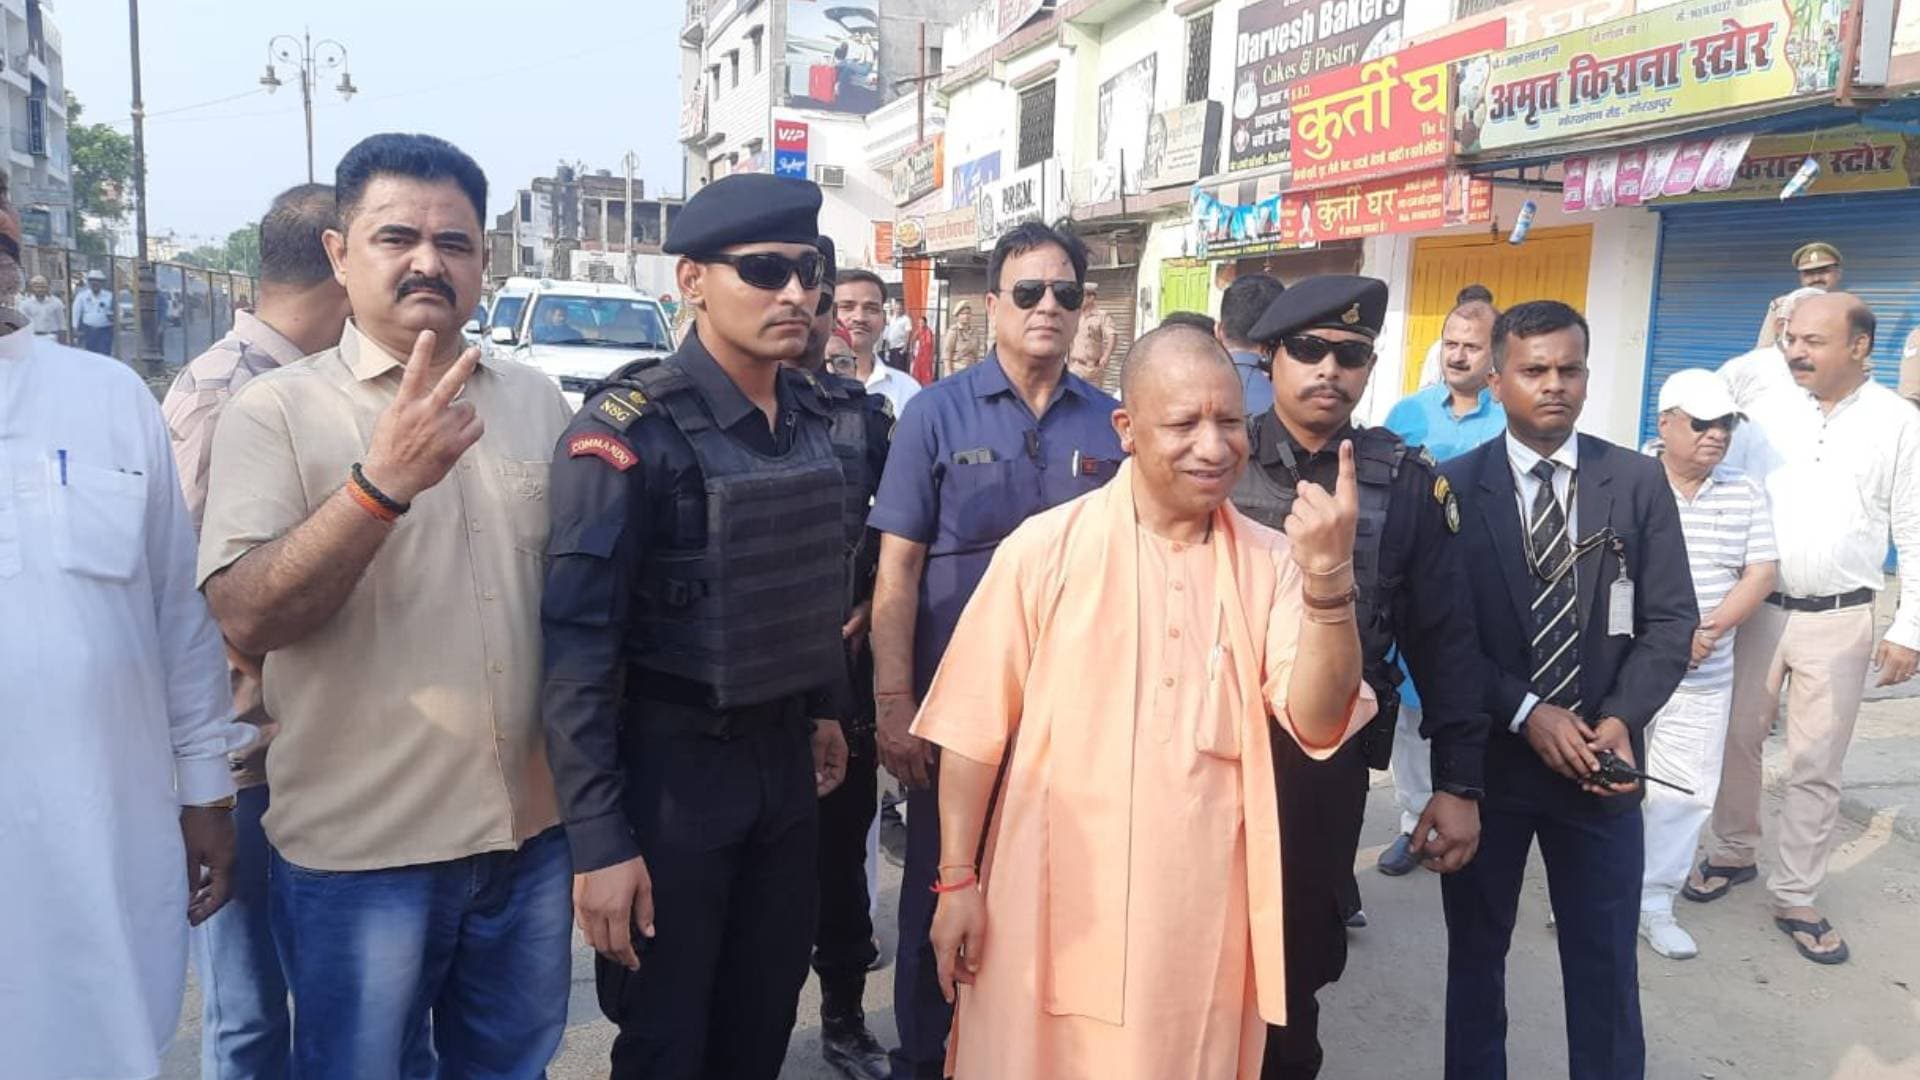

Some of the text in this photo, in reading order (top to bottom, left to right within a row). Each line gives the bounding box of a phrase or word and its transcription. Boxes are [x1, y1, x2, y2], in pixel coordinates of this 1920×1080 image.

[1237, 0, 1400, 67] Darvesh Bakers
[1263, 62, 1297, 86] Cakes
[1315, 42, 1359, 71] Pastry
[1489, 18, 1775, 128] अमृत किराना स्टोर
[1293, 56, 1399, 160] कुर्ती
[1402, 63, 1448, 115] घ
[778, 127, 806, 142] VIP
[1830, 142, 1895, 173] स्टोर
[1315, 184, 1362, 231] कुर्ती
[1365, 188, 1398, 217] घर
[600, 399, 630, 422] NSG
[571, 439, 629, 465] COMMANDO
